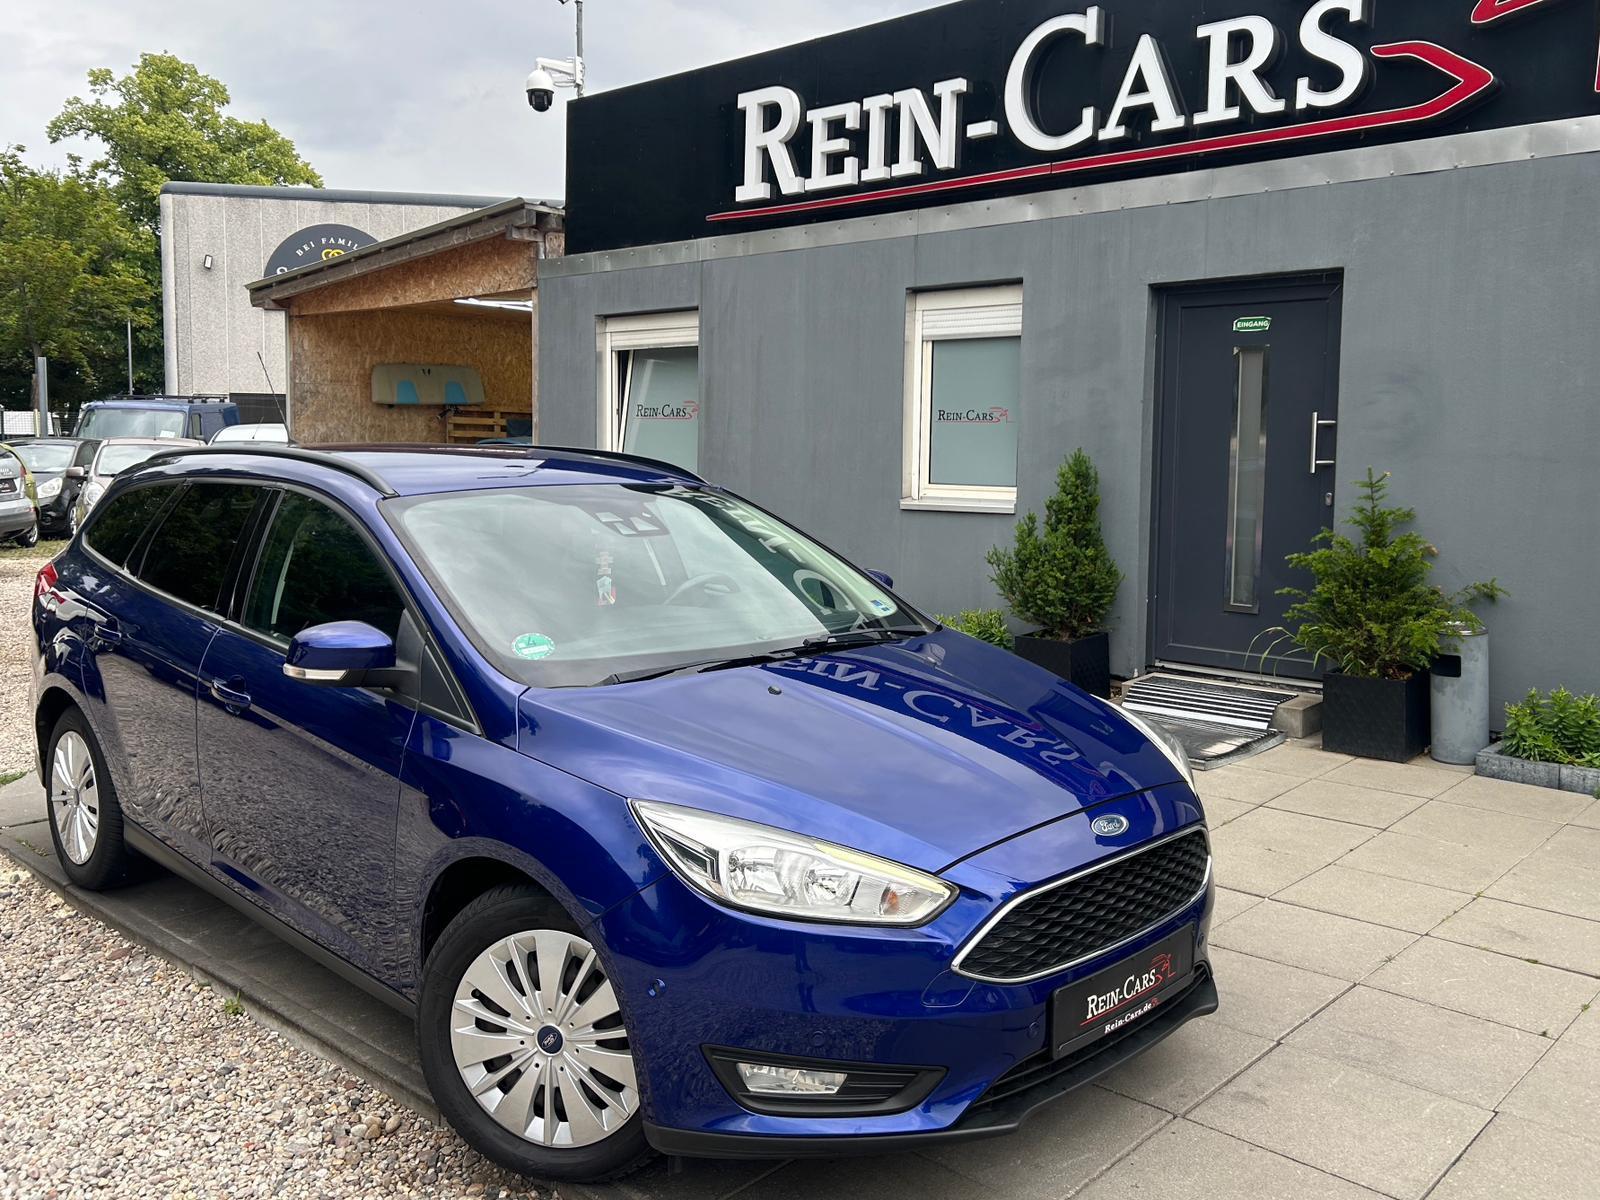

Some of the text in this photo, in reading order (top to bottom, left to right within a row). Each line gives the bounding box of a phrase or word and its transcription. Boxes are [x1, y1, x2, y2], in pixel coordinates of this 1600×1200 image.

[296, 241, 316, 257] BEI
[1237, 320, 1269, 328] EINGANG
[1099, 819, 1121, 832] Ford
[1104, 1002, 1153, 1034] Rein-Cars.de
